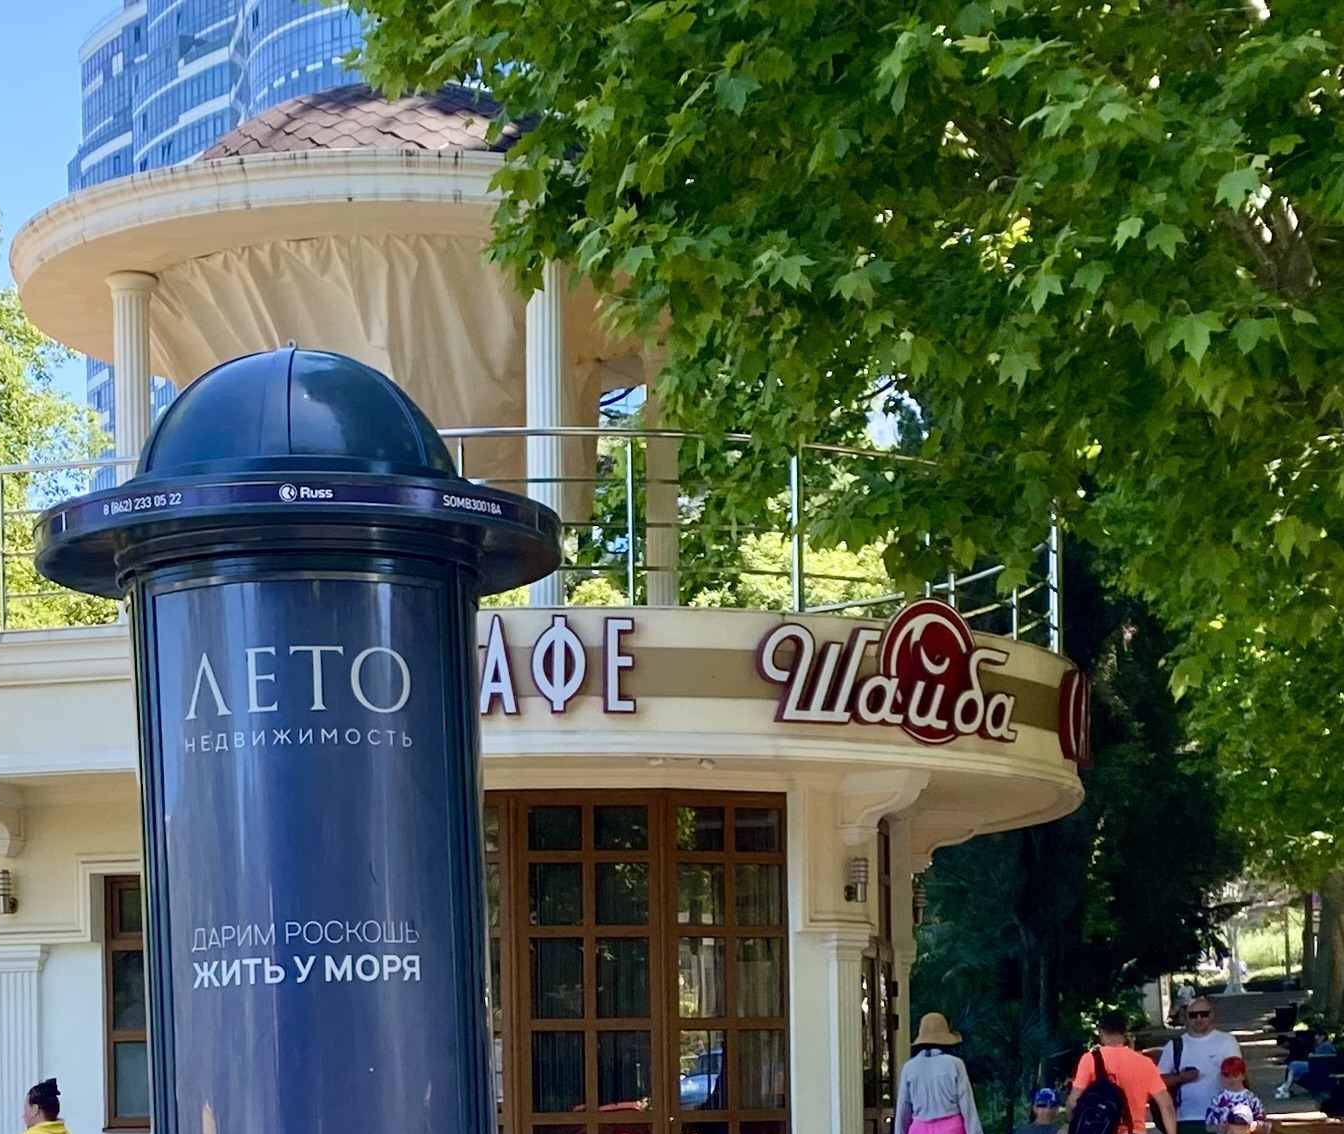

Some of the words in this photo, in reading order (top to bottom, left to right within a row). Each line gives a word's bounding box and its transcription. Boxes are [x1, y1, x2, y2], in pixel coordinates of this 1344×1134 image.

[134, 496, 152, 511] 233
[154, 494, 167, 507] 05
[169, 493, 182, 506] 22
[300, 486, 334, 499] Russ
[479, 614, 637, 715] АФЕ
[184, 645, 412, 721] ЛЕТО
[184, 727, 414, 753] НЕДВИЖИМОСТЬ
[191, 922, 276, 953] ДАРИМ
[285, 919, 421, 945] РОСКОШЬ
[192, 957, 286, 989] ЖИТЬ
[294, 955, 317, 984] У
[325, 954, 421, 983] МОРЯ
